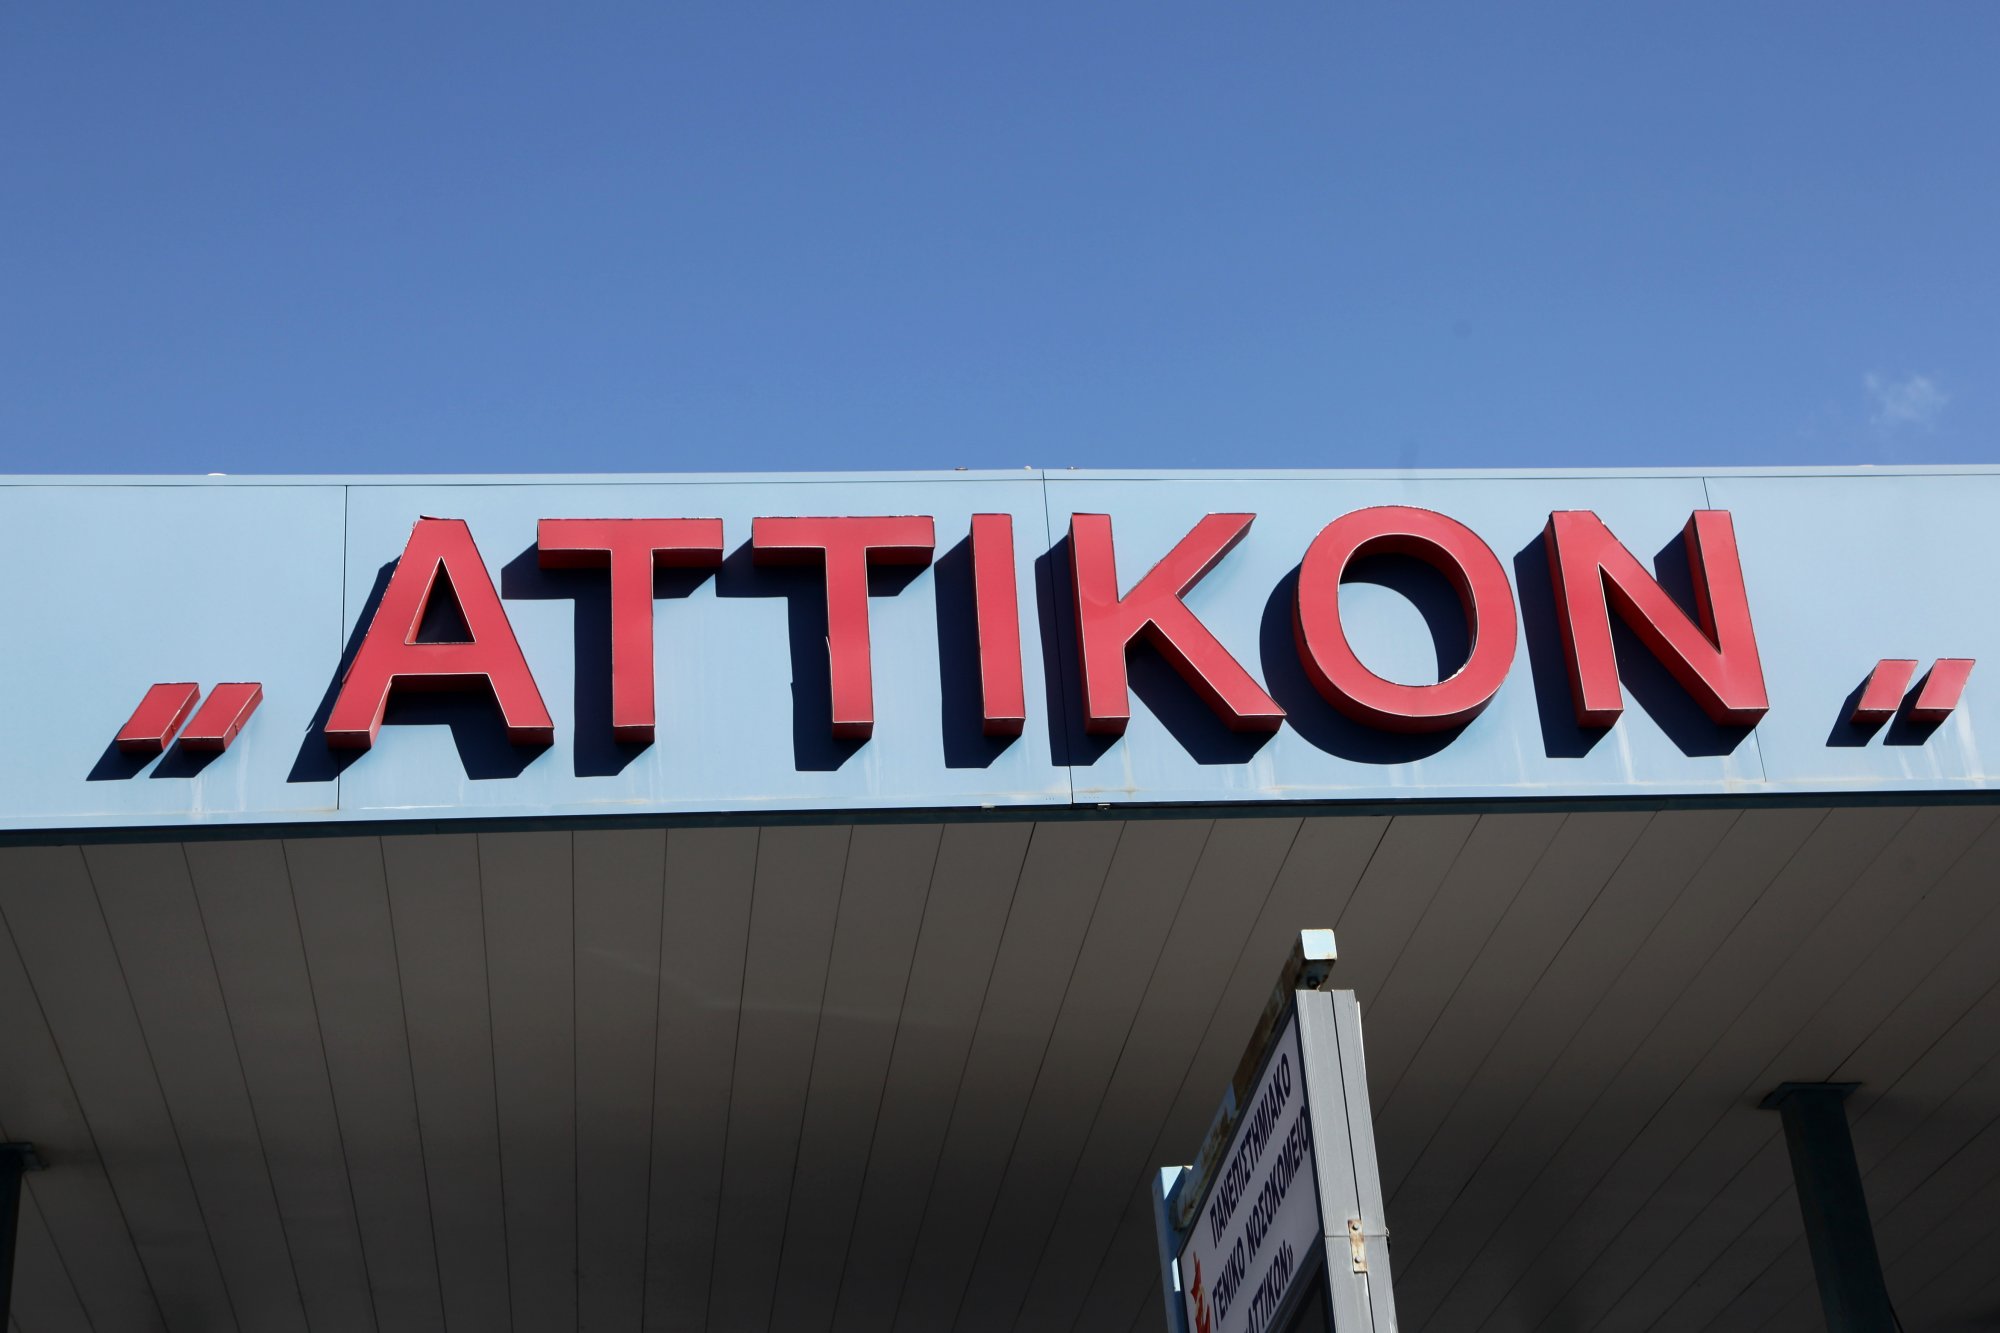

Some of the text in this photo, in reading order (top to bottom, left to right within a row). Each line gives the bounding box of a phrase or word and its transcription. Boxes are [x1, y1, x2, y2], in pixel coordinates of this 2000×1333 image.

[1209, 1052, 1291, 1250] ΠΑΝΕΠΙΣΤΗΜΙΑΚΟ
[1212, 1105, 1309, 1331] ΓΕΝΙΚΟ ΝΟΣΟΚΟΜΕΙΟ
[1244, 1239, 1294, 1333] ΑΤΤΙΚΟΝ»
